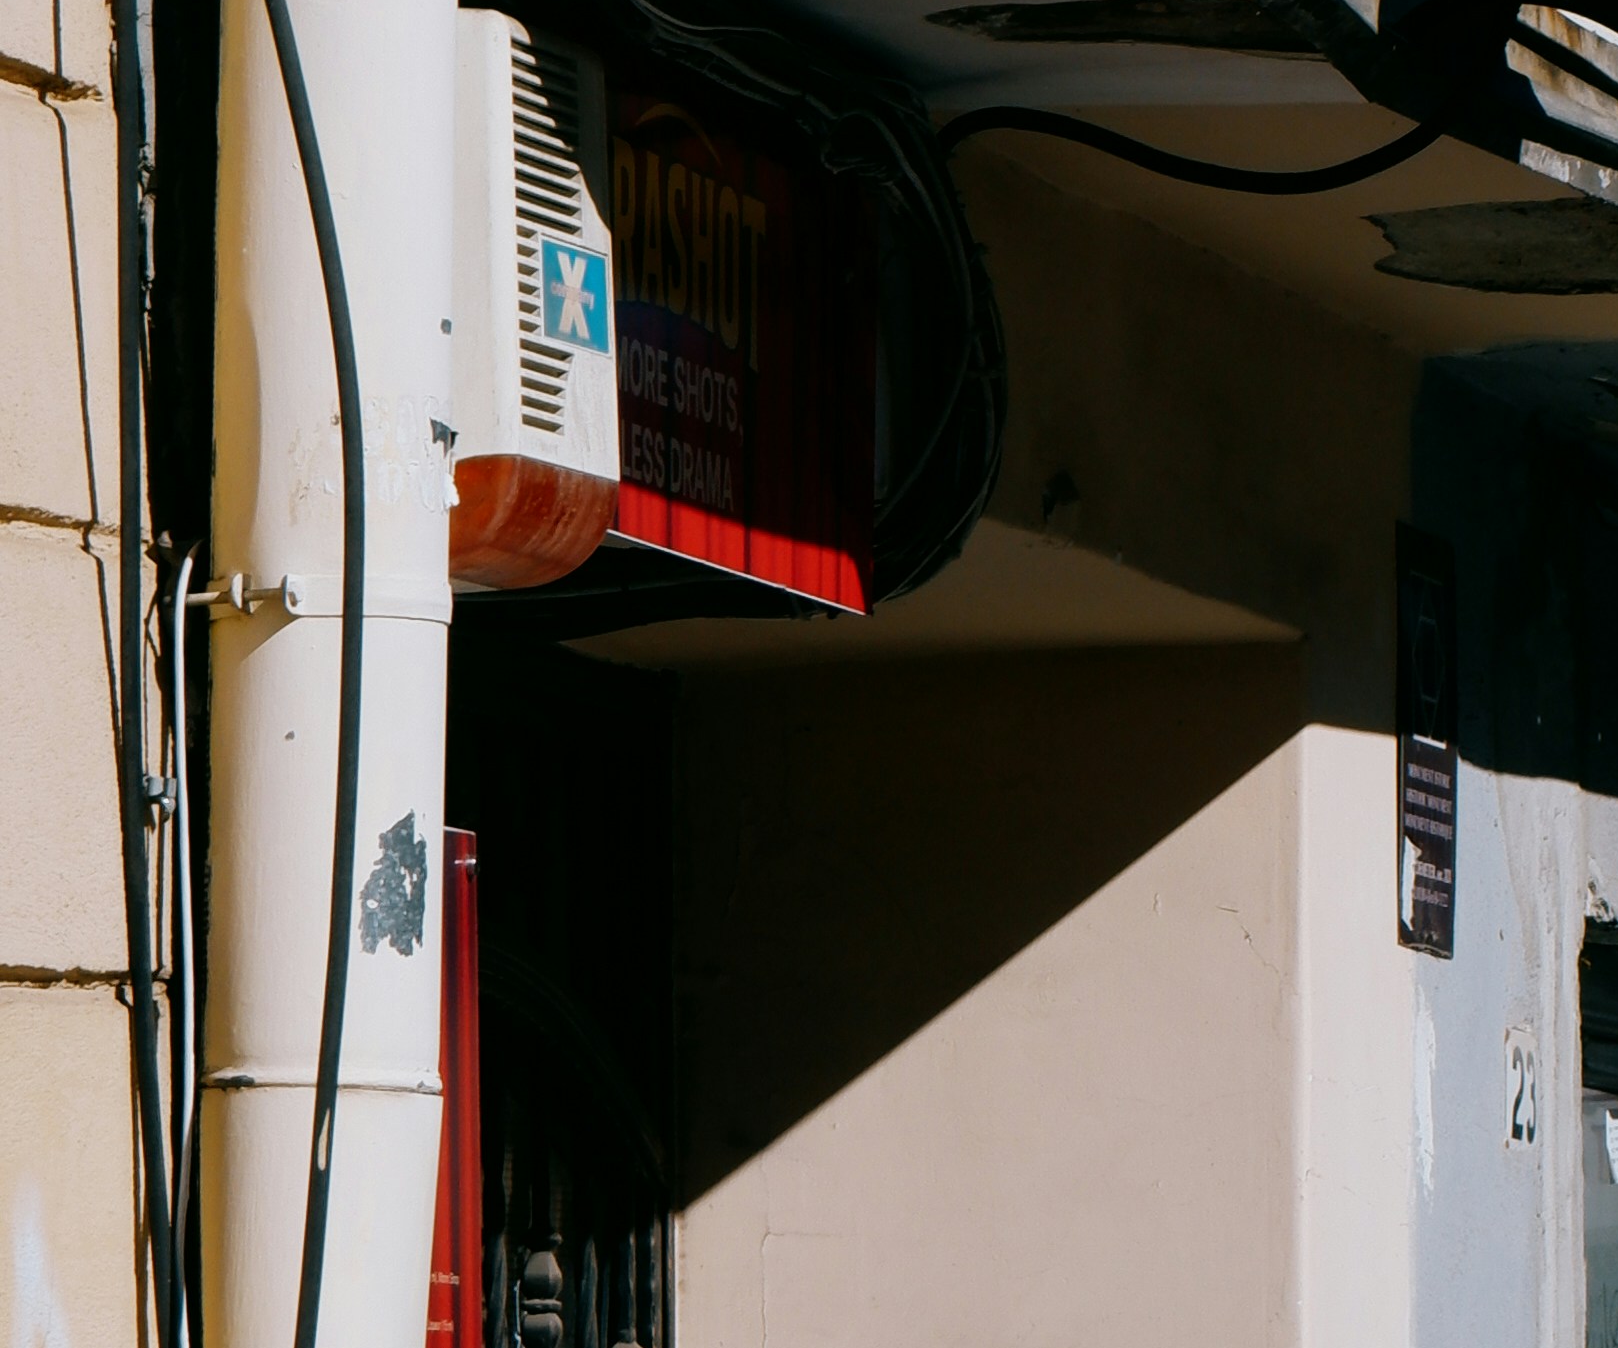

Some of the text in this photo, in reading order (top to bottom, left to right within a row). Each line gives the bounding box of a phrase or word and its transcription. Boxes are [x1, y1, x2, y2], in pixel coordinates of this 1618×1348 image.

[621, 418, 735, 513] LESS DRAMA
[1511, 1045, 1537, 1144] 23
